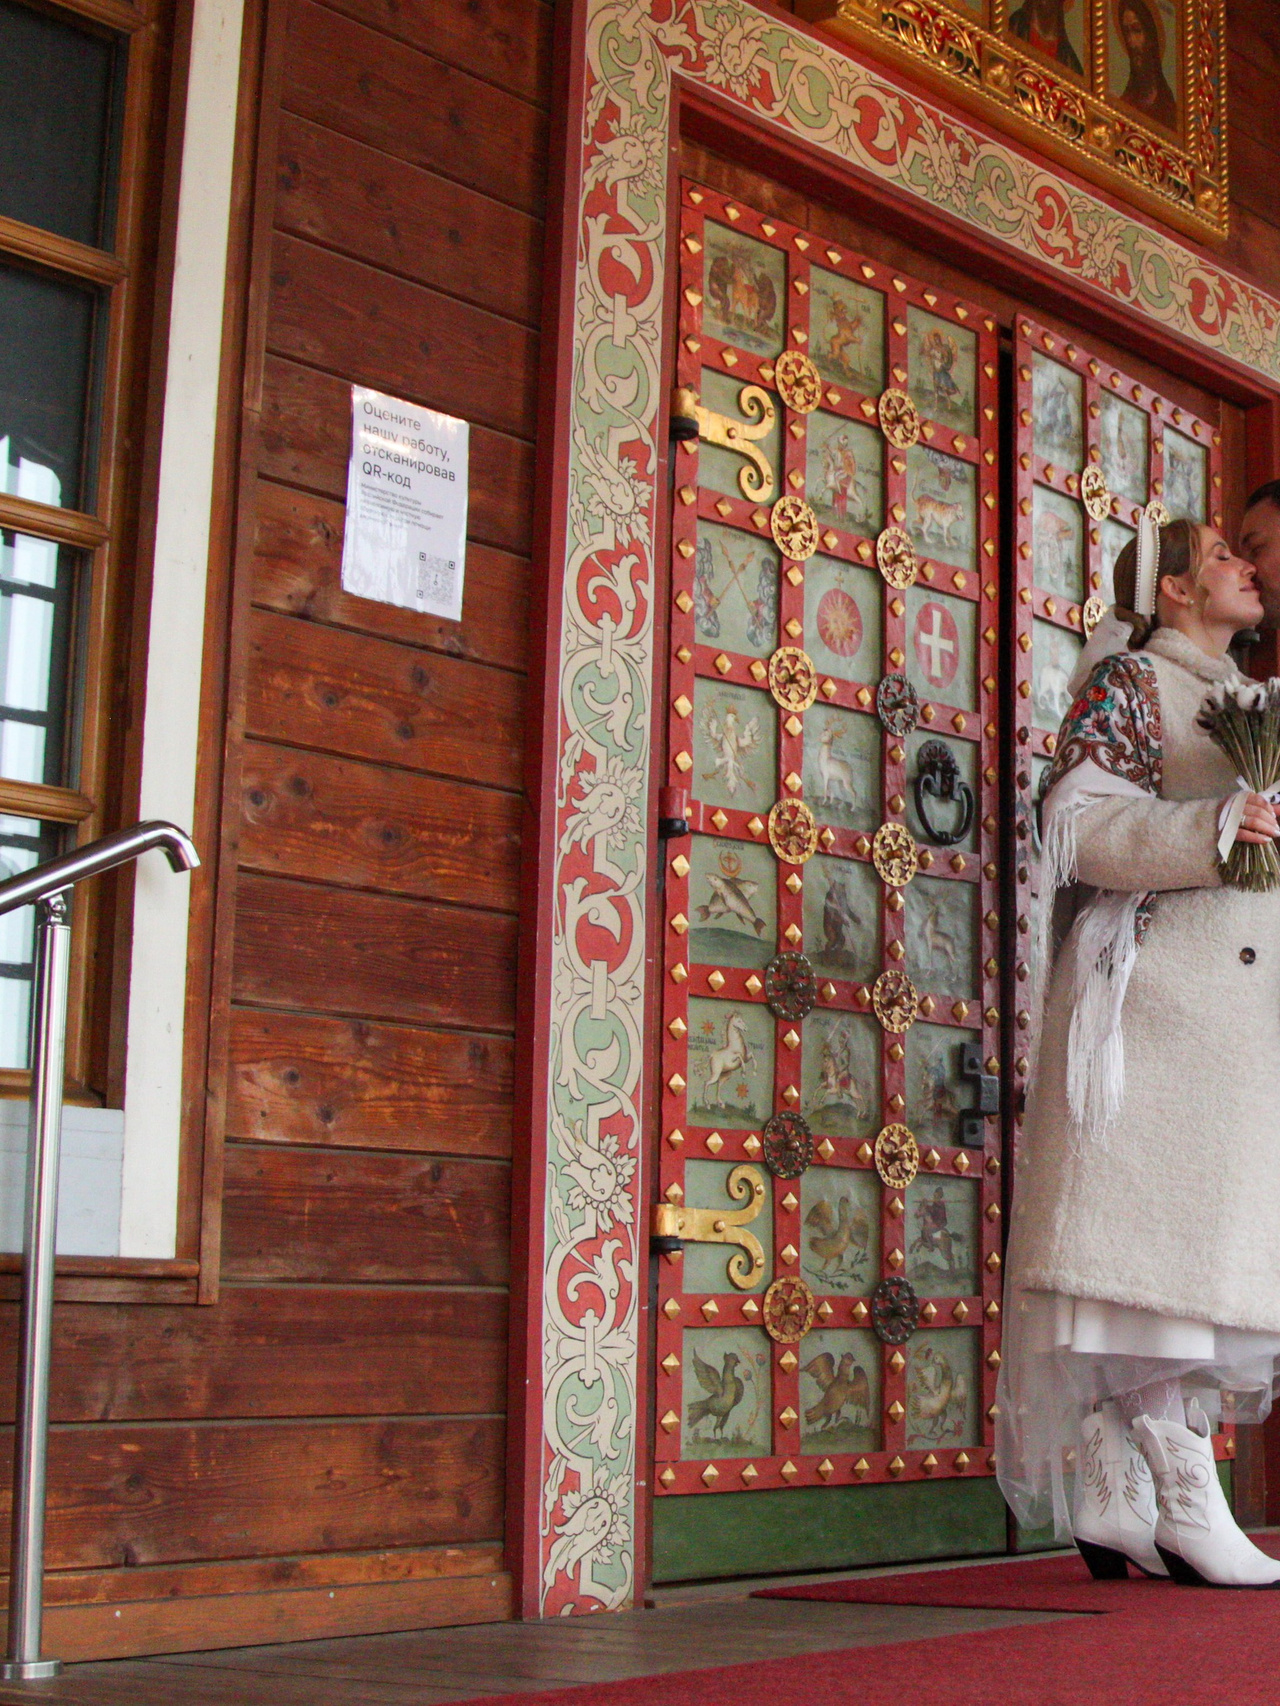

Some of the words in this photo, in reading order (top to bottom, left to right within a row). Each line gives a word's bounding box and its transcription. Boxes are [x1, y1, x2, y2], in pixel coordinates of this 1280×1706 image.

[363, 401, 421, 431] Оцените
[363, 423, 398, 443] нашу
[402, 435, 450, 462] работу,
[362, 461, 412, 490] QR-код
[363, 444, 456, 481] отсканировав
